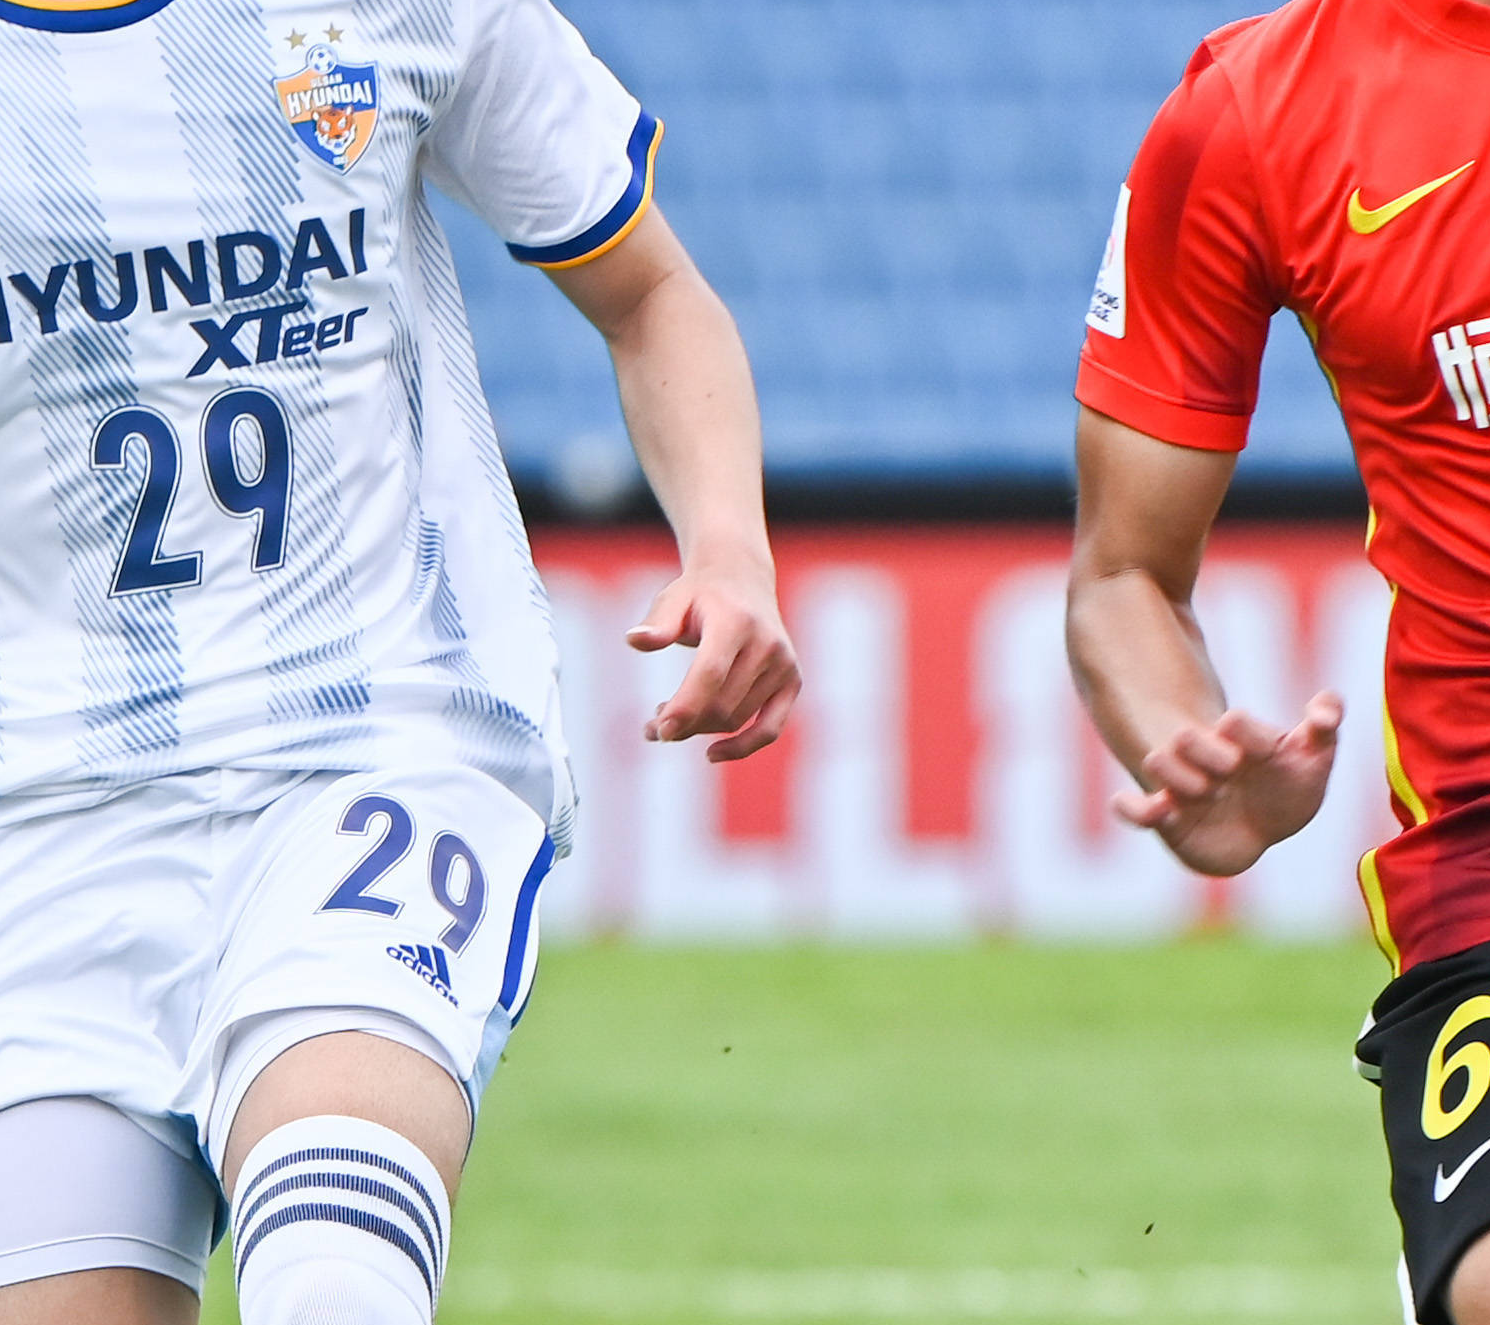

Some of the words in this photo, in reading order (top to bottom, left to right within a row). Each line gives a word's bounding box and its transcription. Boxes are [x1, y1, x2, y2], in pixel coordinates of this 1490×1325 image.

[285, 80, 374, 119] HYUNDAI
[185, 299, 370, 380] XTeer
[87, 386, 296, 600] 29
[313, 791, 490, 959] 29
[386, 945, 459, 1010] adidas
